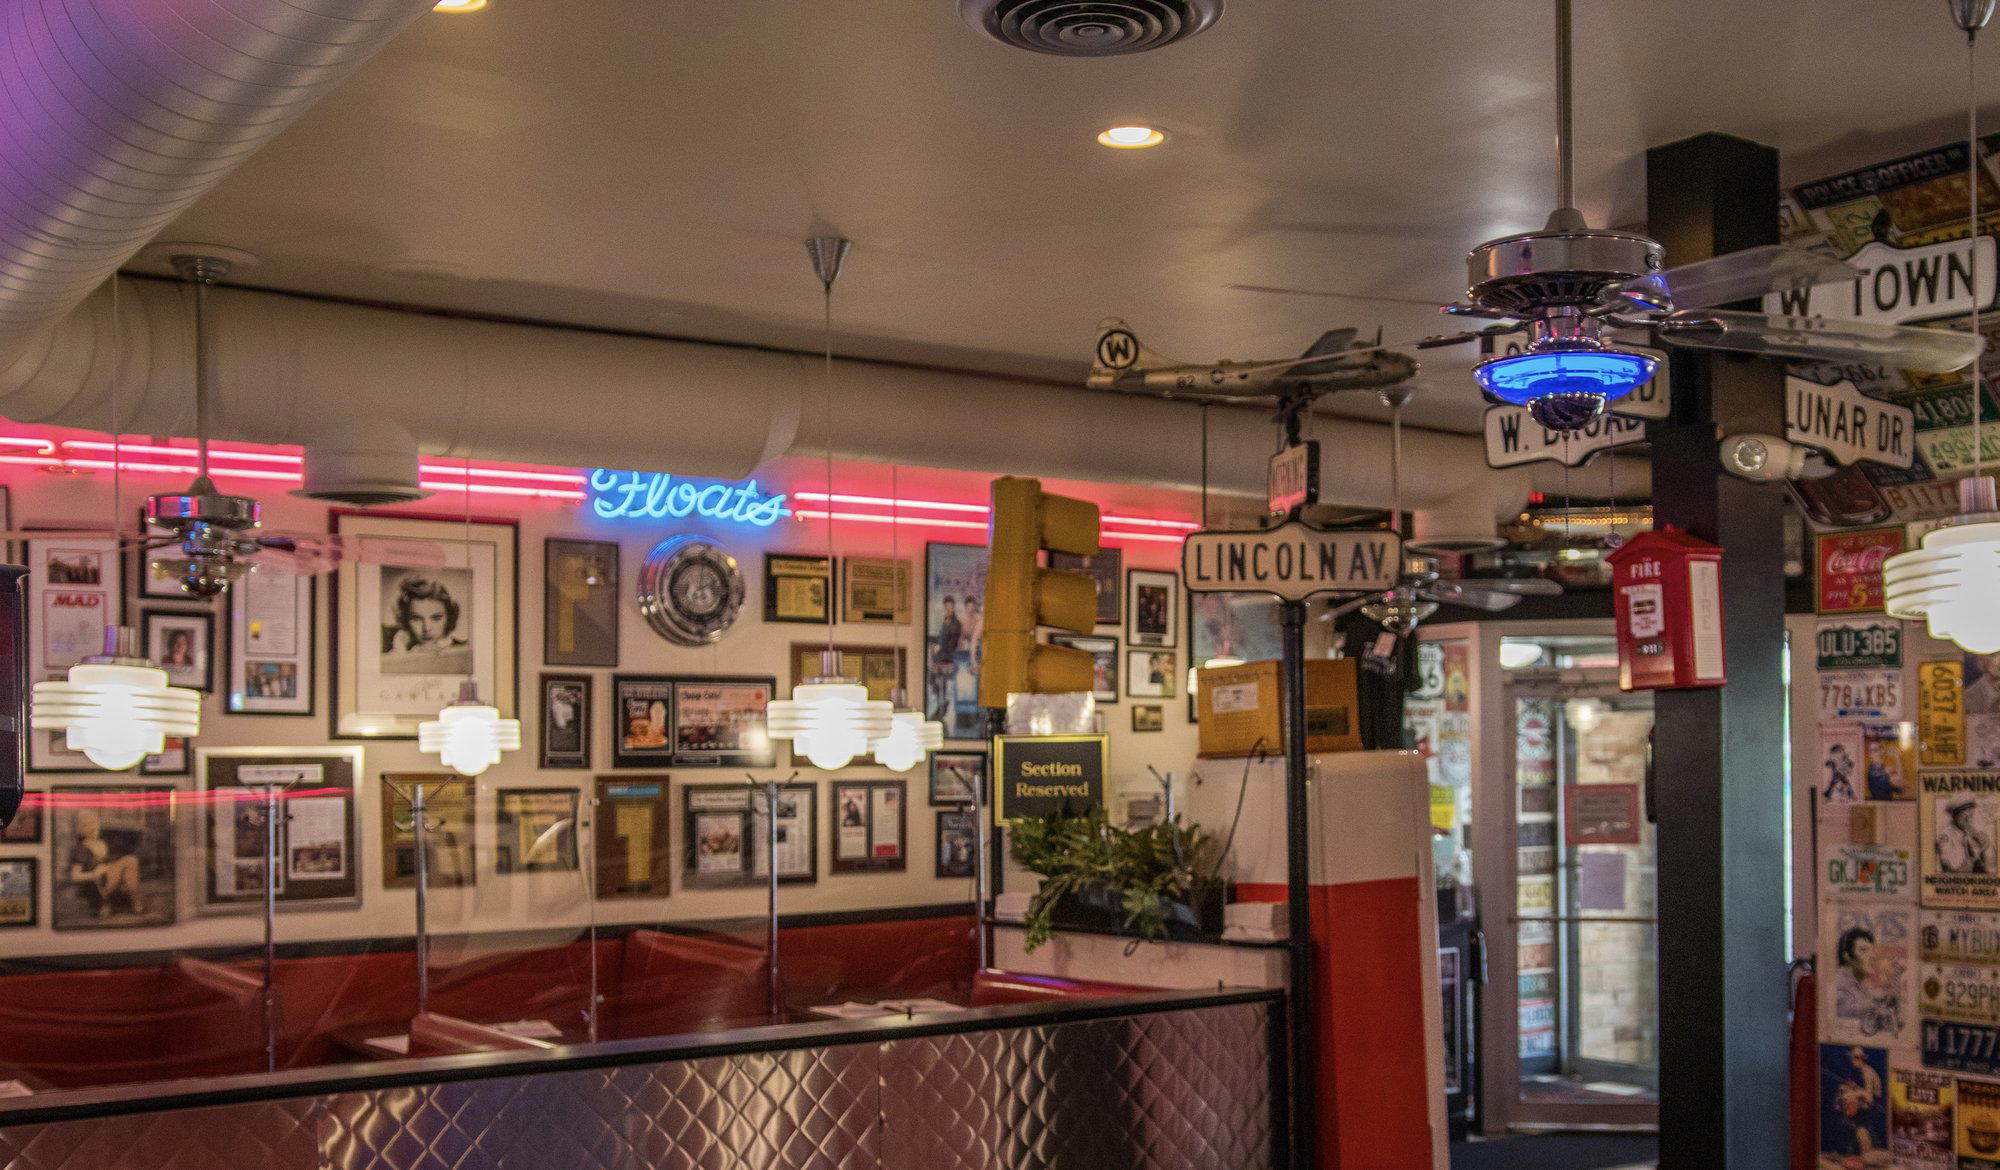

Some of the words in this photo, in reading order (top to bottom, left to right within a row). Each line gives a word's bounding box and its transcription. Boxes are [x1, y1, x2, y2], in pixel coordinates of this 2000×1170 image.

[1878, 152, 1951, 186] OFFICER
[1853, 249, 1975, 316] TOWN
[1105, 337, 1131, 365] W
[1500, 412, 1529, 453] W.
[1786, 389, 1867, 449] UNAR
[1879, 411, 1908, 458] DR.
[591, 468, 792, 527] Floats
[1196, 541, 1337, 582] LINCOLN
[1348, 540, 1390, 581] AV.
[1631, 560, 1662, 579] FIRE
[53, 594, 101, 608] MAD
[1848, 582, 1869, 607] 5
[1021, 760, 1082, 777] Section
[1016, 781, 1090, 798] Reserved
